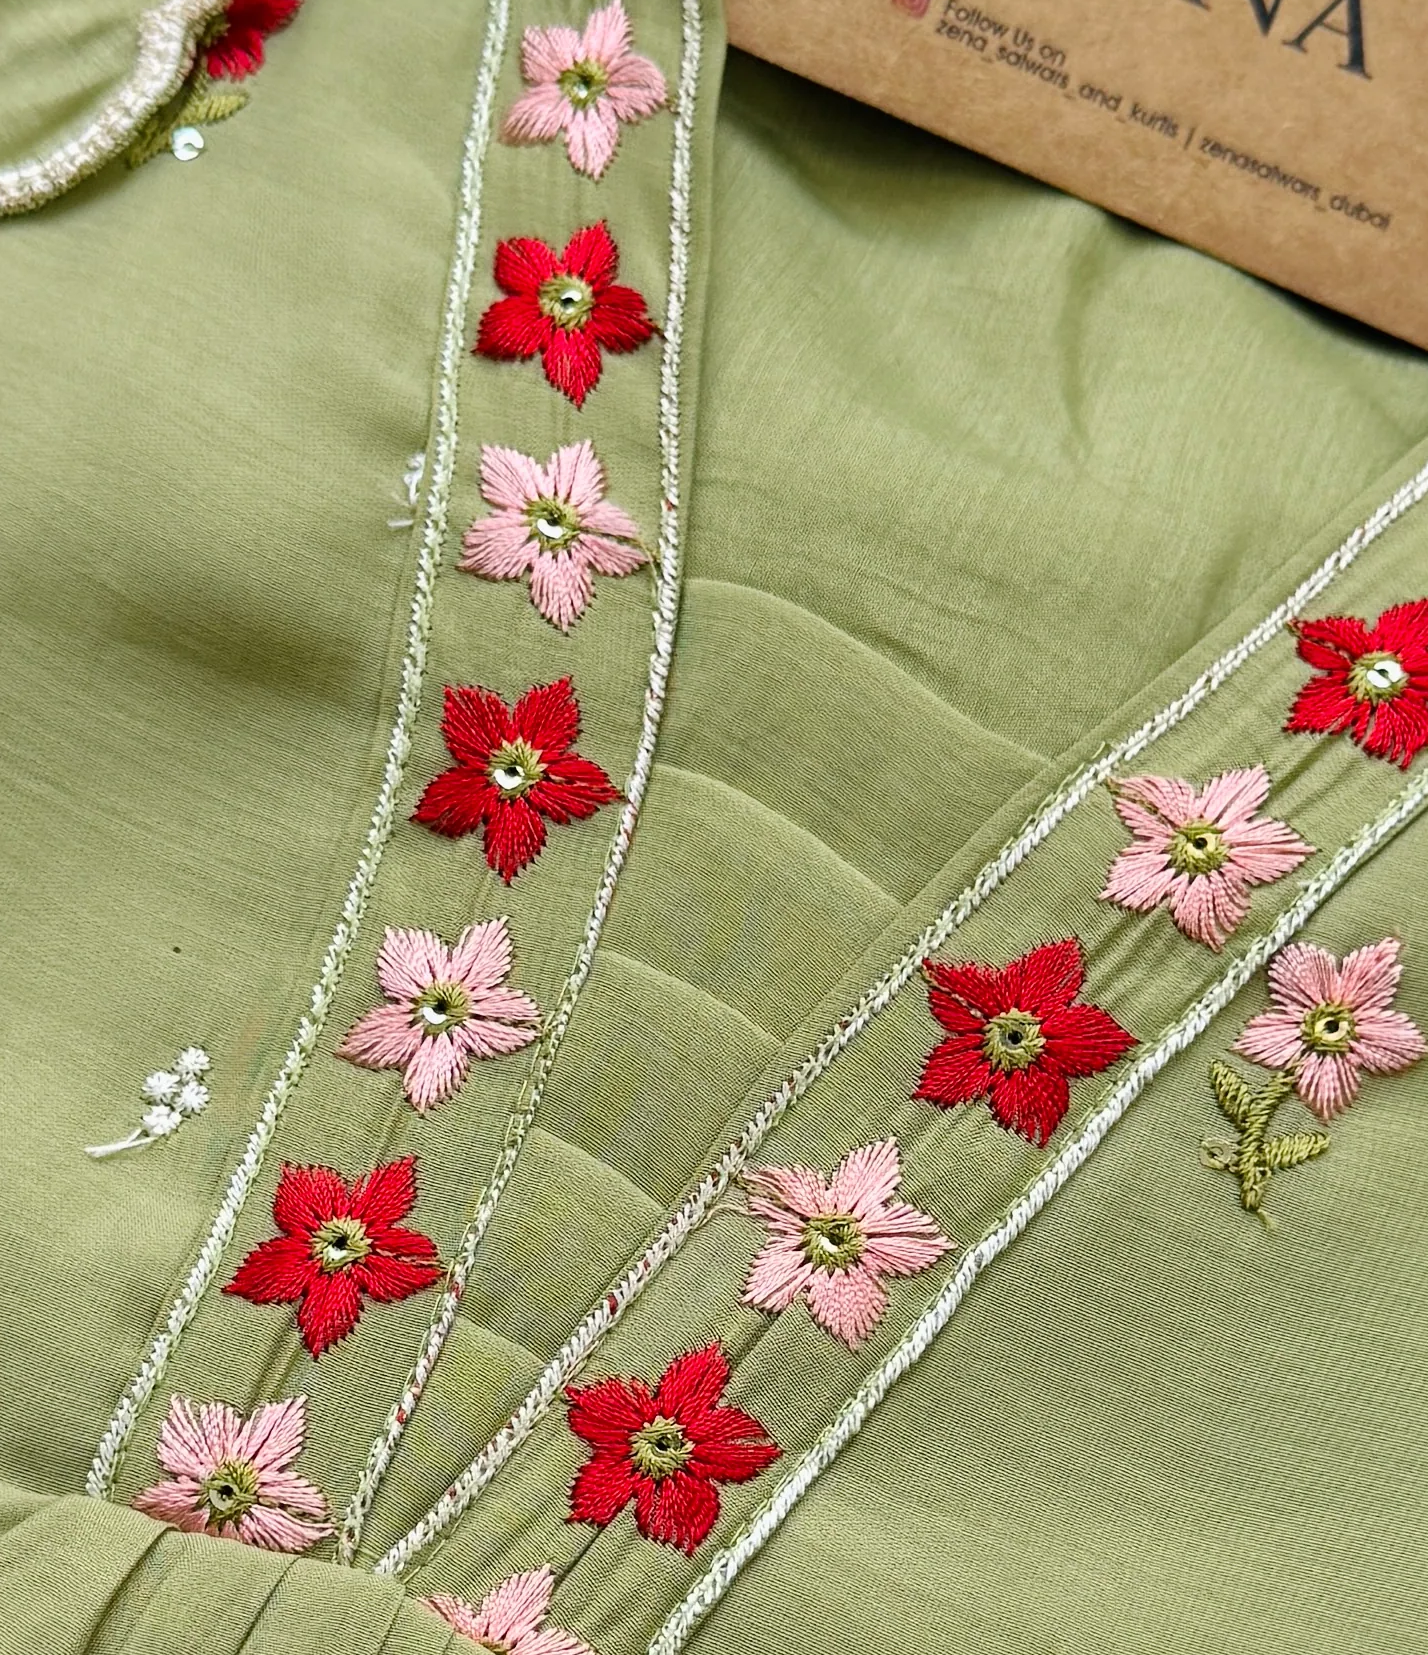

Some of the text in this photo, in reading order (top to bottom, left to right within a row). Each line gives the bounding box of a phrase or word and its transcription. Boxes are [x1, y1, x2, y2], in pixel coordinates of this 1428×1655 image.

[935, 19, 1180, 139] zena_salwars_and_kurtis
[1012, 26, 1034, 52] Us
[1038, 43, 1066, 66] on
